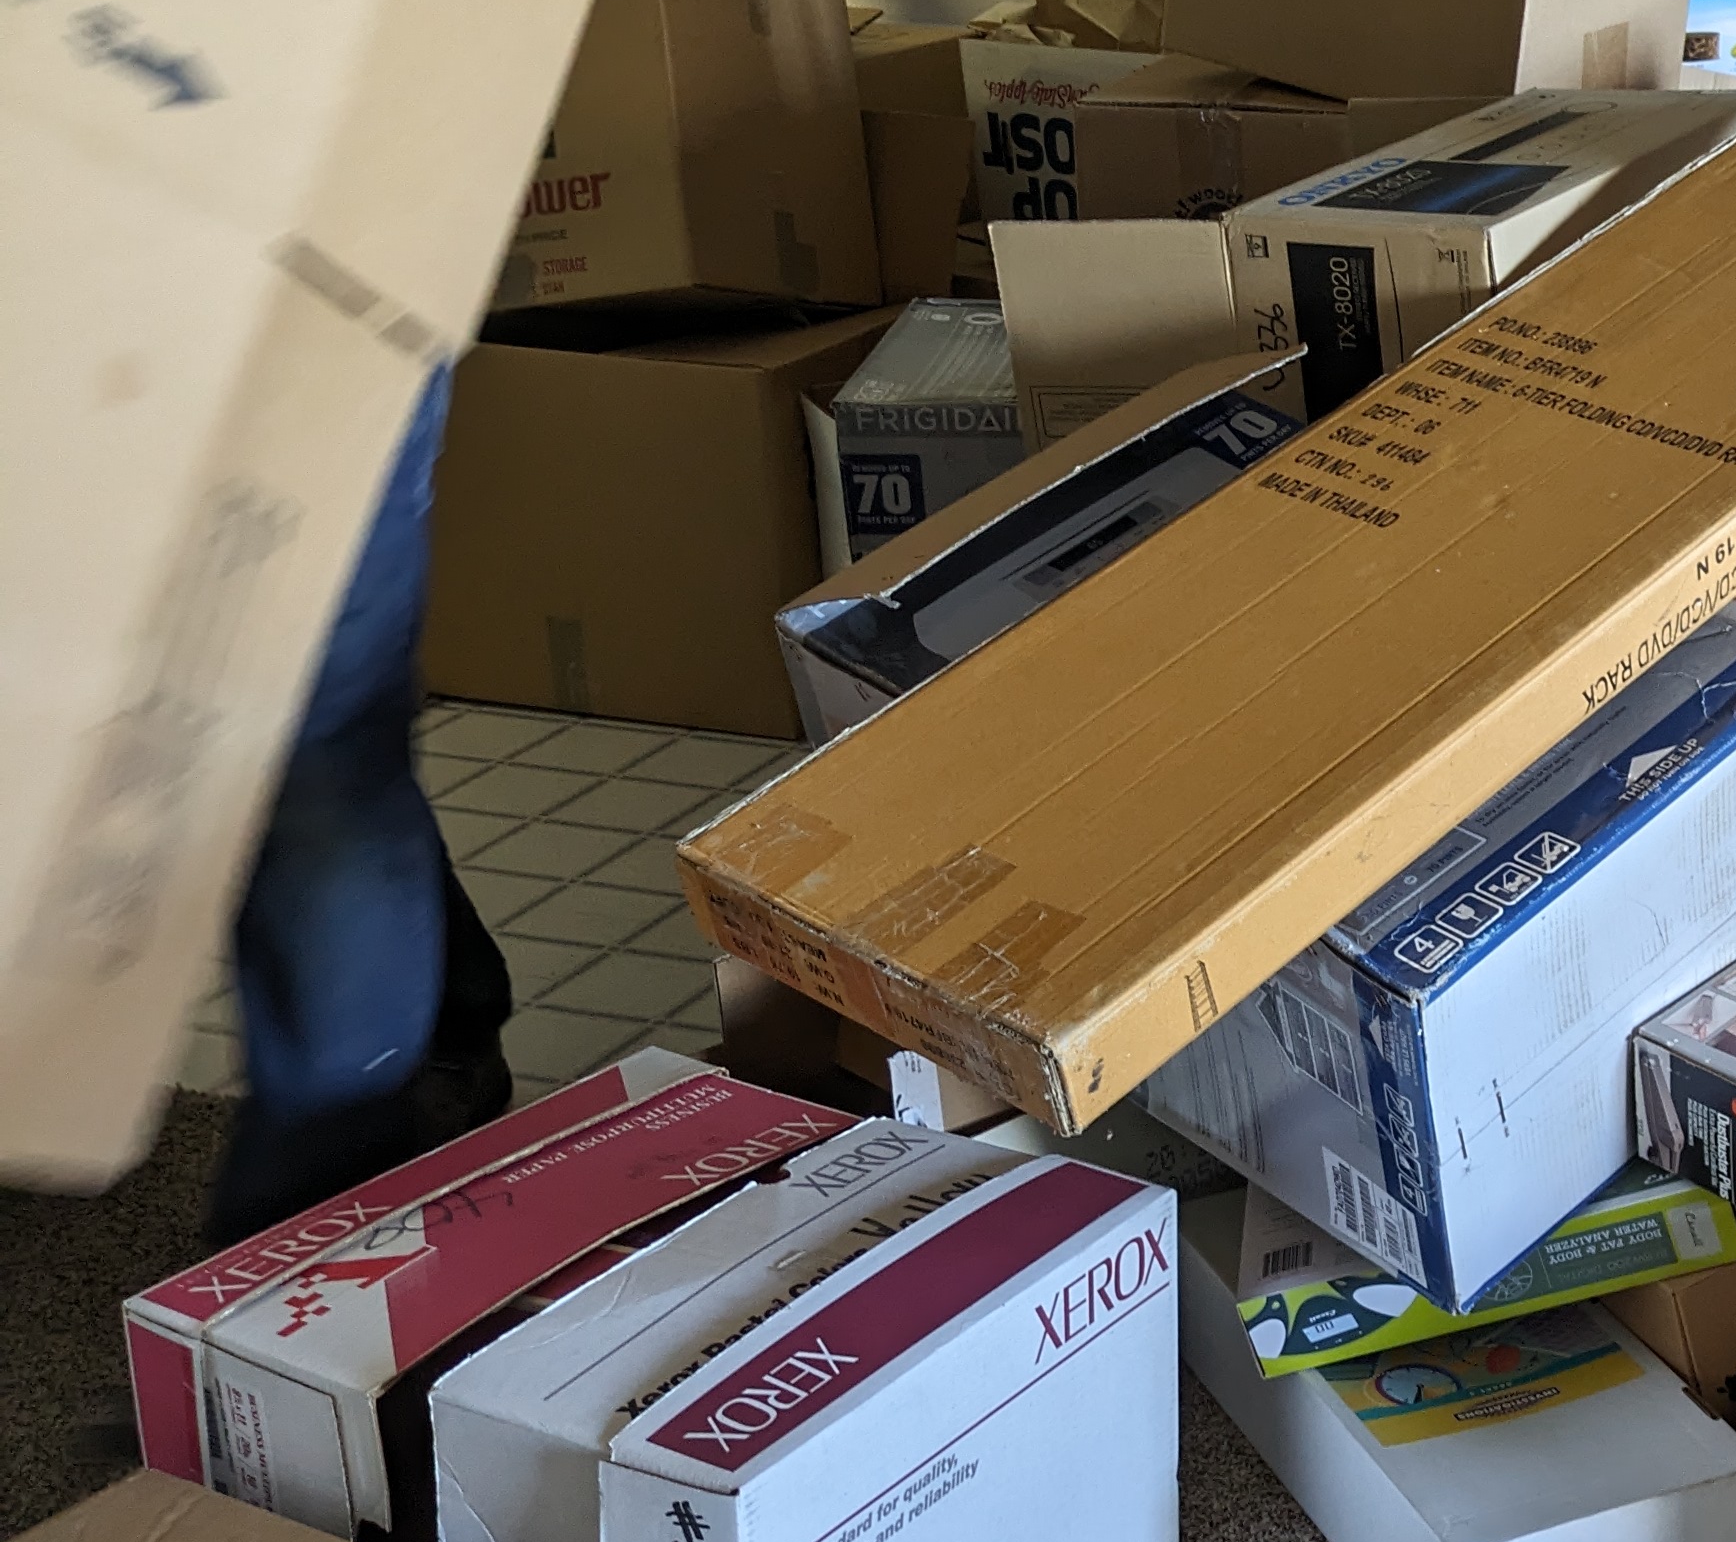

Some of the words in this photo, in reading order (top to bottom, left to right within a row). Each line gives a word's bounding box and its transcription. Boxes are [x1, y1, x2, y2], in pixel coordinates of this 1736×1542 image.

[1328, 256, 1358, 351] TX-8020
[1456, 337, 1492, 361] ITEM
[1425, 358, 1462, 384] ITEM
[1512, 383, 1571, 412] 6-TIER
[1566, 397, 1629, 431] FOLDING
[854, 406, 1022, 433] FRIGIDAI
[1201, 409, 1279, 456] 70
[1328, 425, 1378, 448] SKU#
[1294, 448, 1328, 472] CTN
[853, 473, 912, 515] 70
[1257, 472, 1313, 499] MADE
[1300, 485, 1325, 505] IN
[1319, 491, 1400, 529] THAILAND
[1696, 561, 1710, 581] N
[1580, 653, 1634, 715] RACK
[1617, 774, 1649, 803] THIS
[1648, 747, 1684, 776] SIDE
[1680, 736, 1700, 758] UP
[1414, 936, 1434, 956] 4
[572, 1083, 718, 1160] MULTIPURPOSE
[644, 1089, 733, 1131] BUSINESS
[660, 1112, 840, 1187] XEROX
[790, 1130, 929, 1198] XEROX
[1717, 1112, 1731, 1175] Dustbuster
[500, 1145, 568, 1187] PAPER
[1718, 1173, 1732, 1200] Plus
[1544, 1229, 1611, 1253] ANALYZER
[1601, 1237, 1624, 1253] FAT
[1613, 1218, 1658, 1238] WATER
[1634, 1229, 1663, 1248] BODY
[189, 1198, 399, 1305] XEROX
[1549, 1245, 1582, 1266] BODY
[1034, 1218, 1172, 1365] XEROX
[683, 1336, 860, 1452] XEROX
[1454, 1386, 1561, 1422] INVESTIGATIONS
[876, 1493, 900, 1530] for
[902, 1453, 959, 1503] quality,
[907, 1458, 980, 1524] reliability
